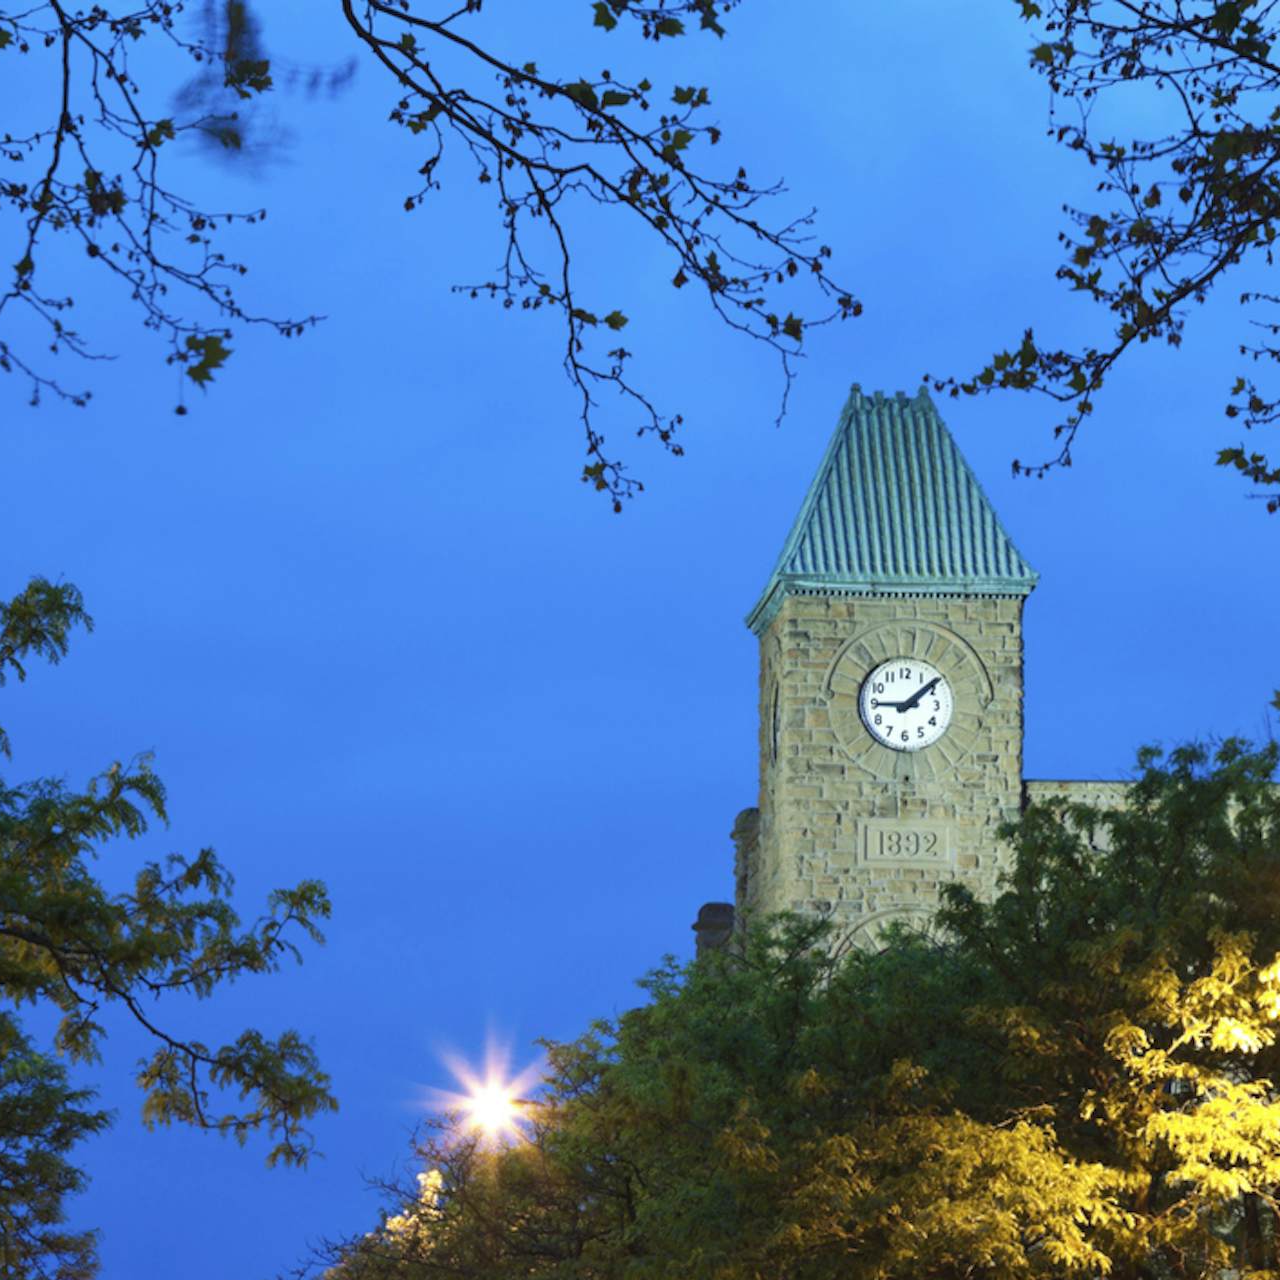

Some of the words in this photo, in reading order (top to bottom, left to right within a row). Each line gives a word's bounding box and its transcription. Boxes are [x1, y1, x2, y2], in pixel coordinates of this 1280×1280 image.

[885, 671, 895, 683] 11
[899, 667, 912, 679] 12
[872, 682, 885, 694] 10
[870, 698, 879, 710] 9
[933, 699, 941, 712] 3
[874, 713, 882, 726] 8
[928, 716, 937, 727] 4
[886, 725, 894, 737] 7
[900, 730, 910, 742] 6
[917, 726, 925, 738] 5
[879, 830, 939, 856] 1892
